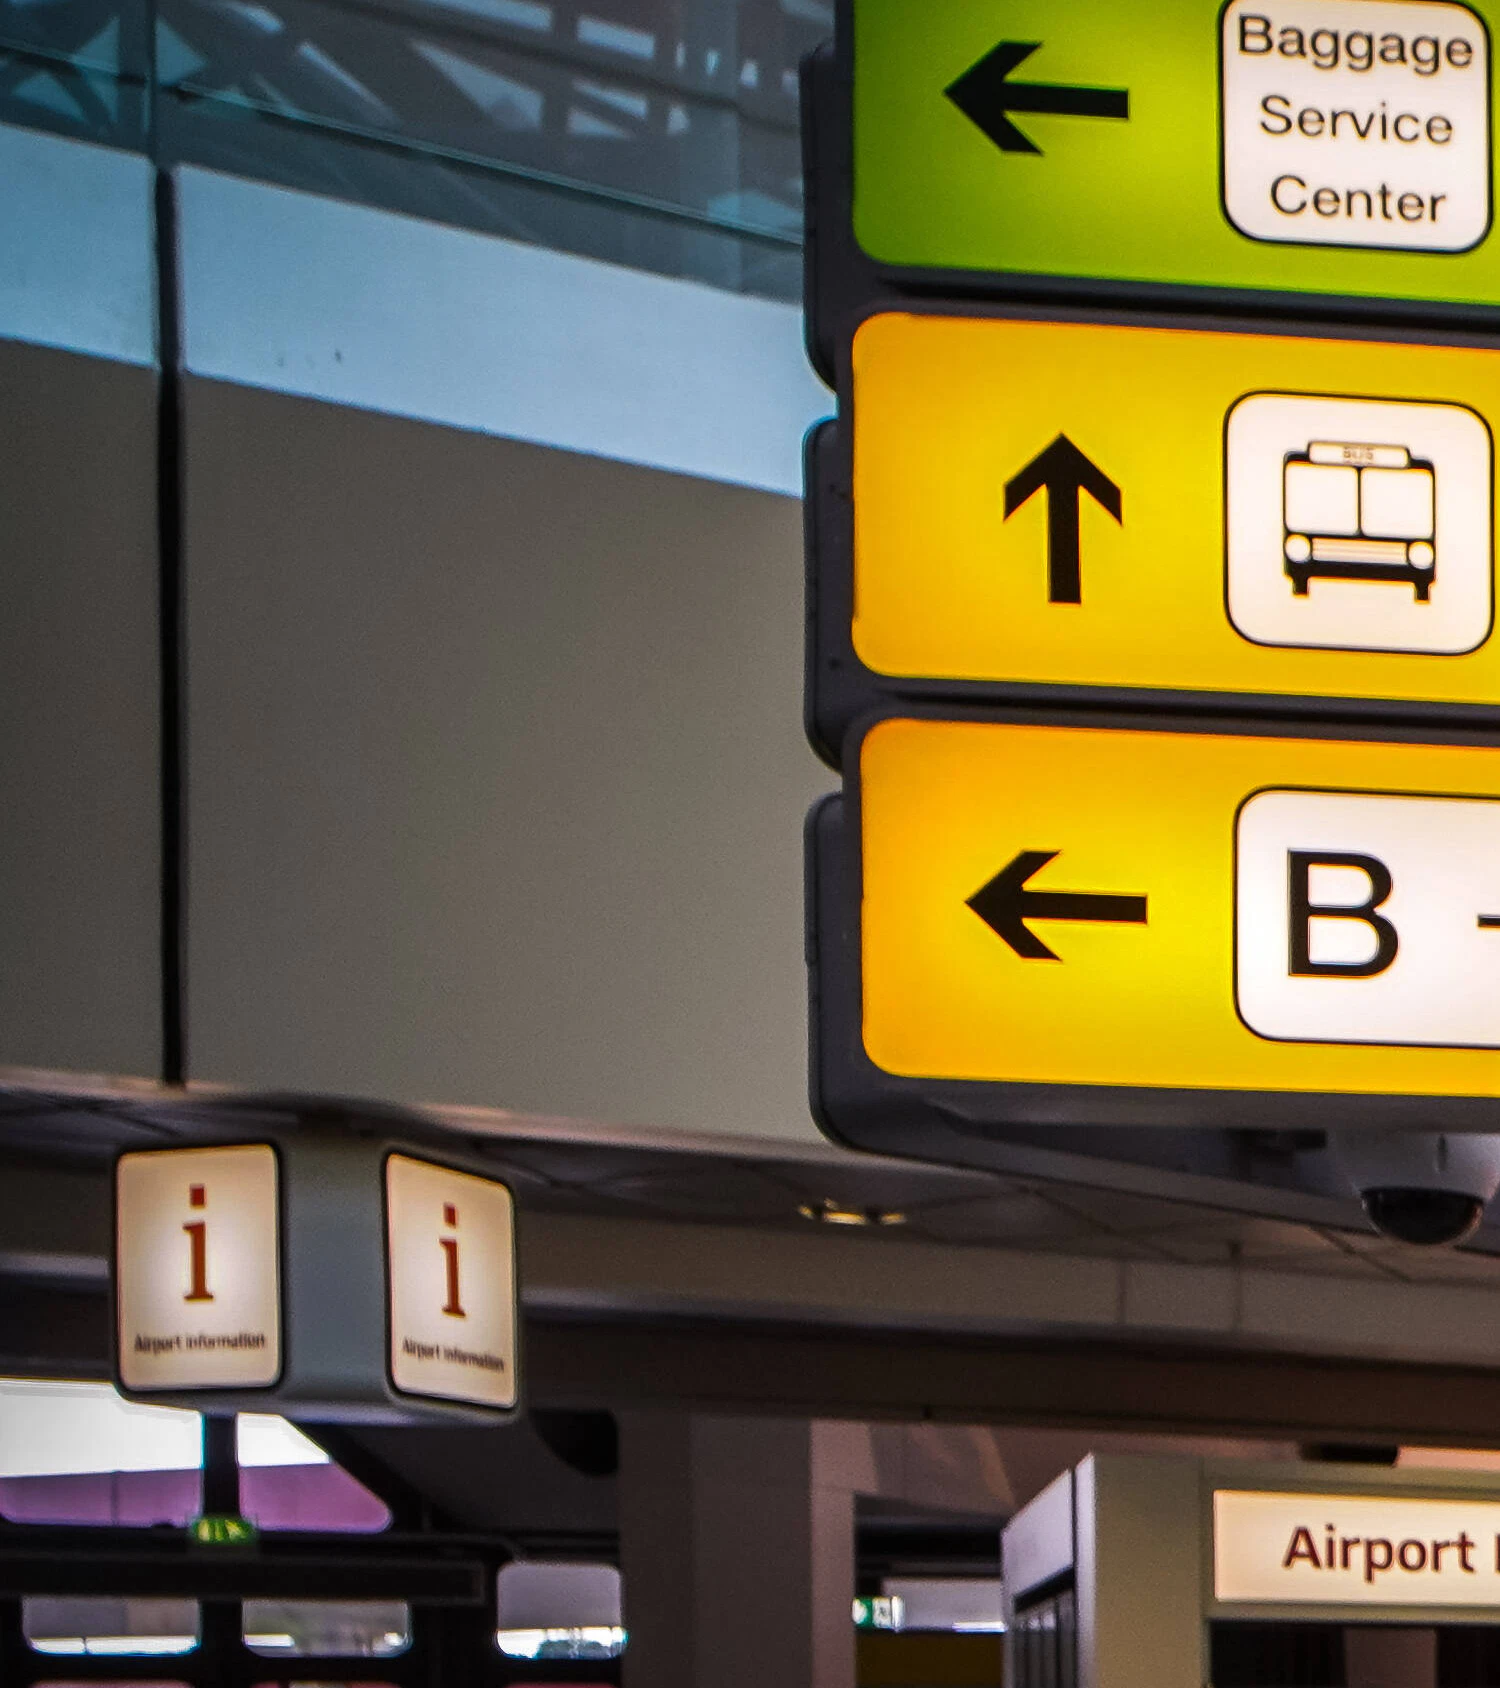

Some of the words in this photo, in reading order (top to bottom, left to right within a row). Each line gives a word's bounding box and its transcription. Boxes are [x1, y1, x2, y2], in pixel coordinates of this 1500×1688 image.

[1238, 14, 1474, 74] Baggage
[1260, 94, 1453, 145] Service
[1270, 174, 1446, 223] Center
[1286, 849, 1400, 980] B
[1282, 1523, 1476, 1584] Airport
